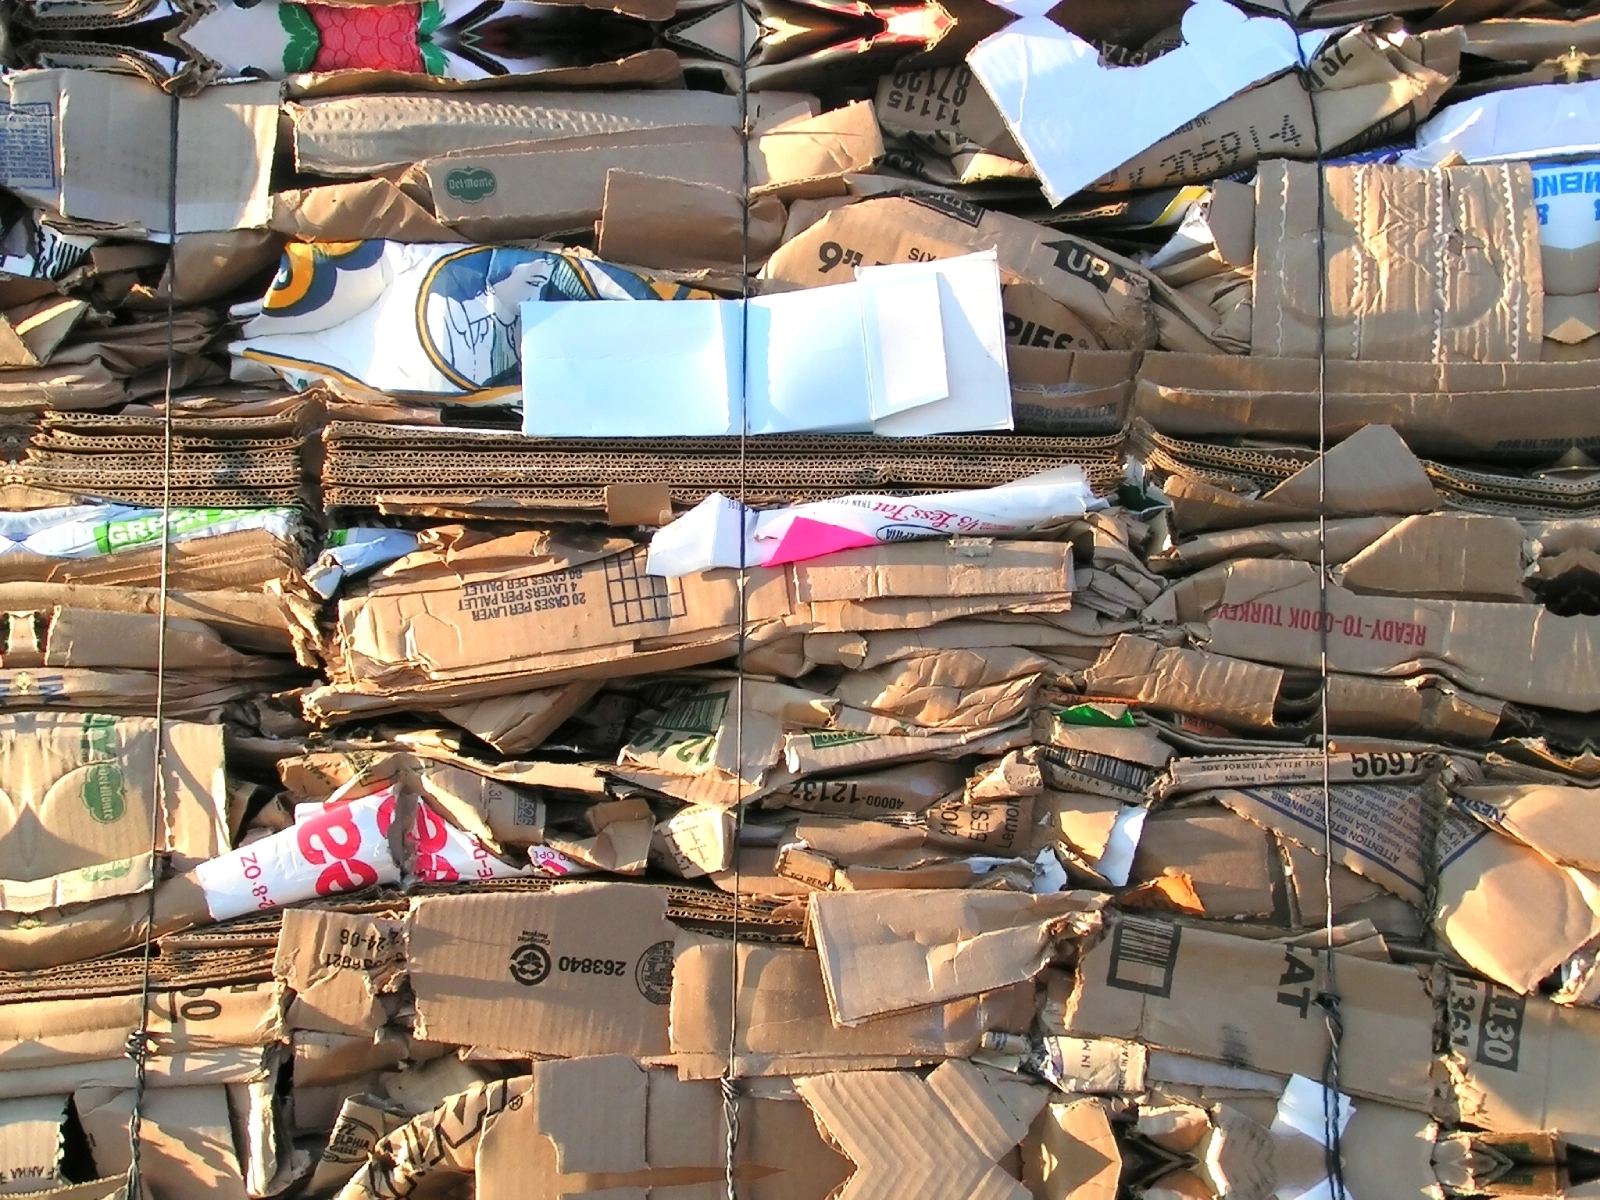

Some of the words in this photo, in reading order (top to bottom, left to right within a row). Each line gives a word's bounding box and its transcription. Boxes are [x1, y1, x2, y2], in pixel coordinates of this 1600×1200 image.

[887, 91, 960, 125] 11115
[1067, 246, 1111, 280] UP
[1015, 402, 1118, 418] PREPARATION
[871, 501, 908, 521] Fat
[907, 505, 952, 528] Less
[507, 579, 527, 589] PER
[531, 573, 565, 585] CASES
[571, 582, 577, 591] 4
[464, 582, 503, 596] PALLET
[502, 591, 523, 601] PER
[526, 584, 567, 598] LAYERS
[458, 593, 497, 610] PALLET
[534, 596, 569, 610] CASES
[573, 593, 585, 604] 20
[472, 606, 506, 621] LAYER
[509, 602, 531, 615] PER
[1289, 607, 1426, 645] READY-TO-COOK
[1224, 762, 1271, 770] FORMULA
[1270, 790, 1314, 817] OWNERS
[1329, 792, 1370, 817] payment
[1333, 808, 1354, 824] may
[1364, 799, 1402, 825] products
[1354, 819, 1376, 837] USA
[1348, 830, 1400, 863] ATTENTION
[241, 853, 260, 878] OZ
[807, 877, 846, 891] REMOVE
[558, 956, 627, 976] 263840
[1277, 944, 1316, 1019] AT
